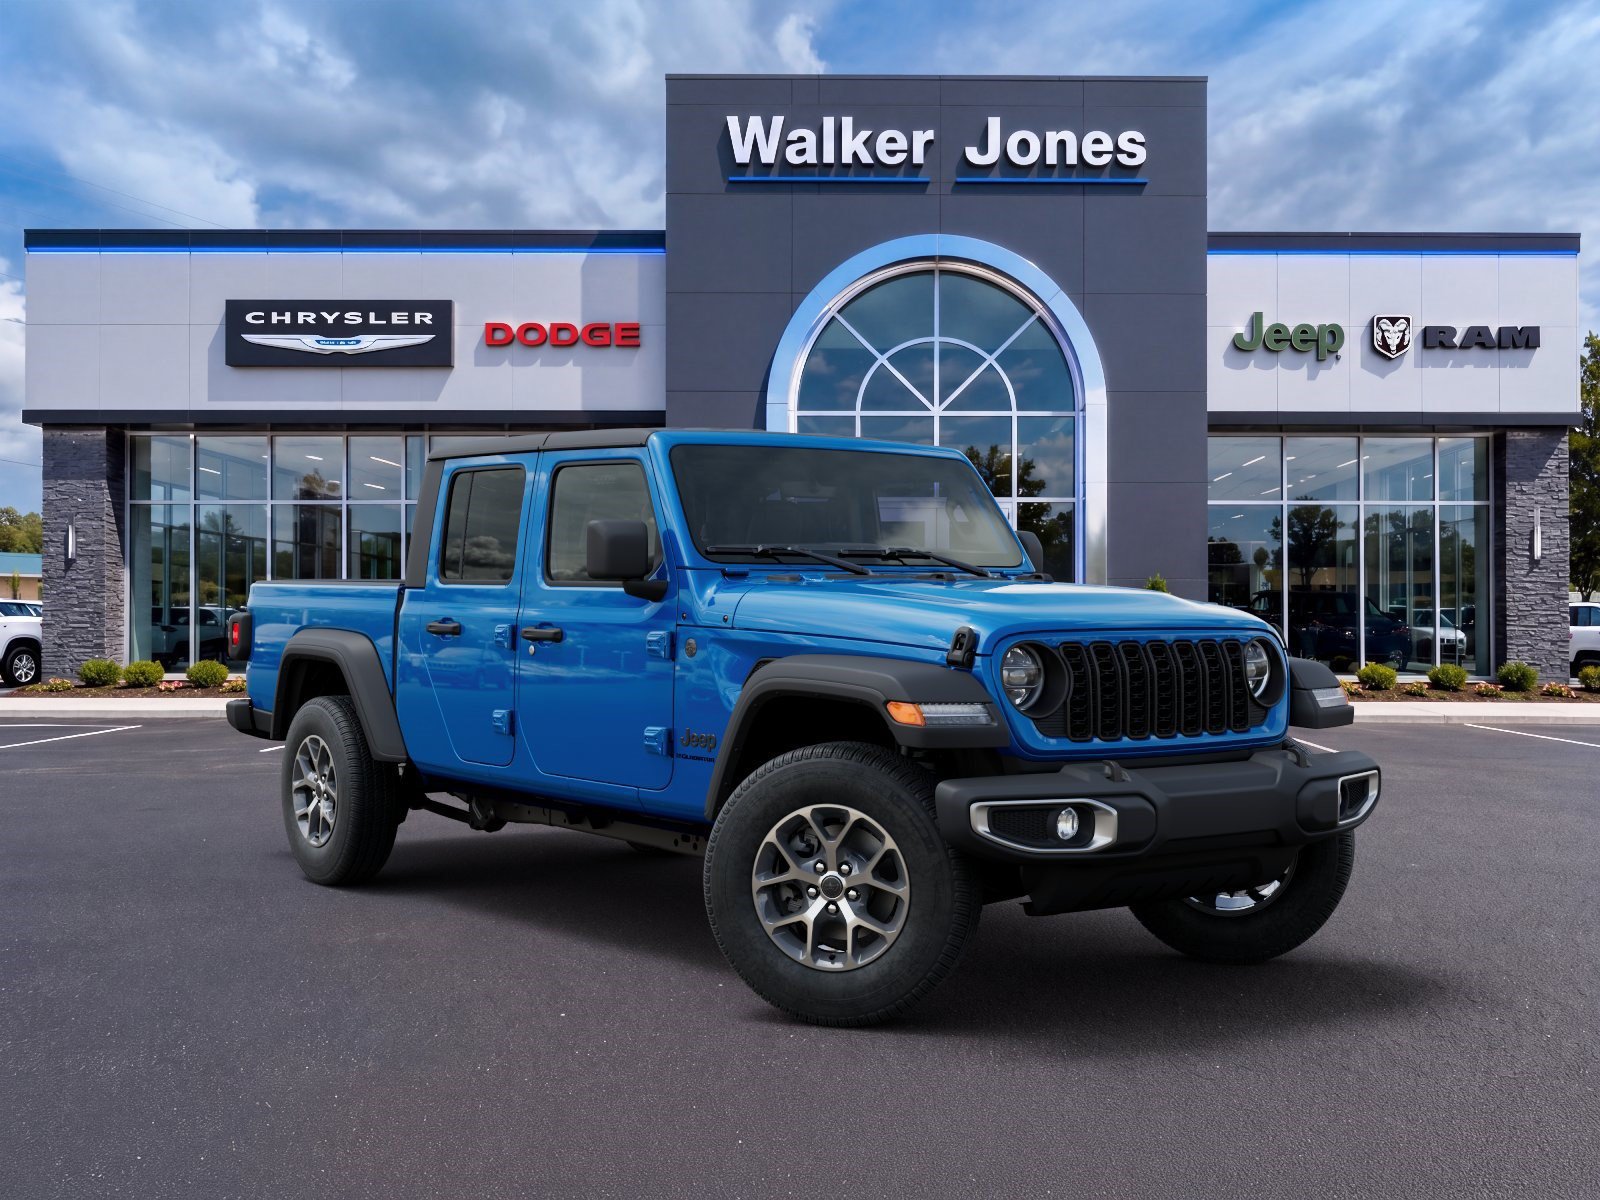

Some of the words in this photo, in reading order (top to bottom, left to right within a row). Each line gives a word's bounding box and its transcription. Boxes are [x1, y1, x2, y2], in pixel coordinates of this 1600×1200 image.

[726, 115, 935, 166] Walker
[964, 116, 1148, 167] Jones
[244, 311, 434, 325] CHRYSLER
[484, 322, 641, 347] DODGE
[1233, 311, 1346, 361] Jeep
[1423, 325, 1541, 349] RAM
[680, 727, 717, 753] Jeep
